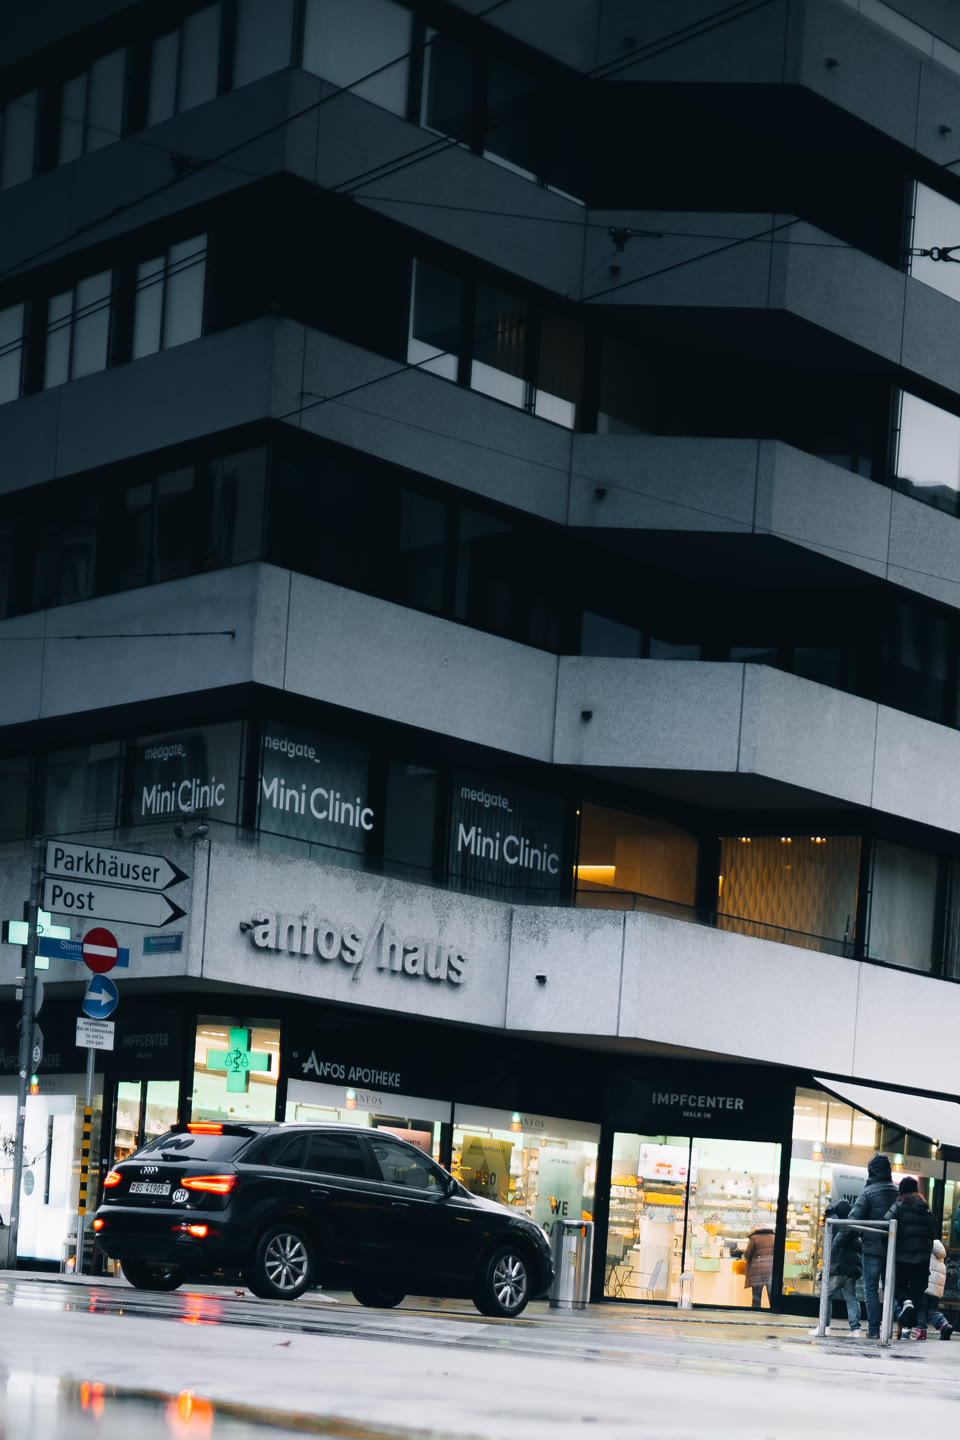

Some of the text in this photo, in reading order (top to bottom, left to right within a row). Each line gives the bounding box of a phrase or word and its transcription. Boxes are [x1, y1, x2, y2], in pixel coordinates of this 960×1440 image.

[53, 847, 160, 883] Parkhäuser
[51, 884, 95, 912] Post
[301, 1049, 401, 1088] ANFOS APOTHEKE
[651, 1092, 744, 1110] IMPFCENTER
[174, 1190, 187, 1201] CH
